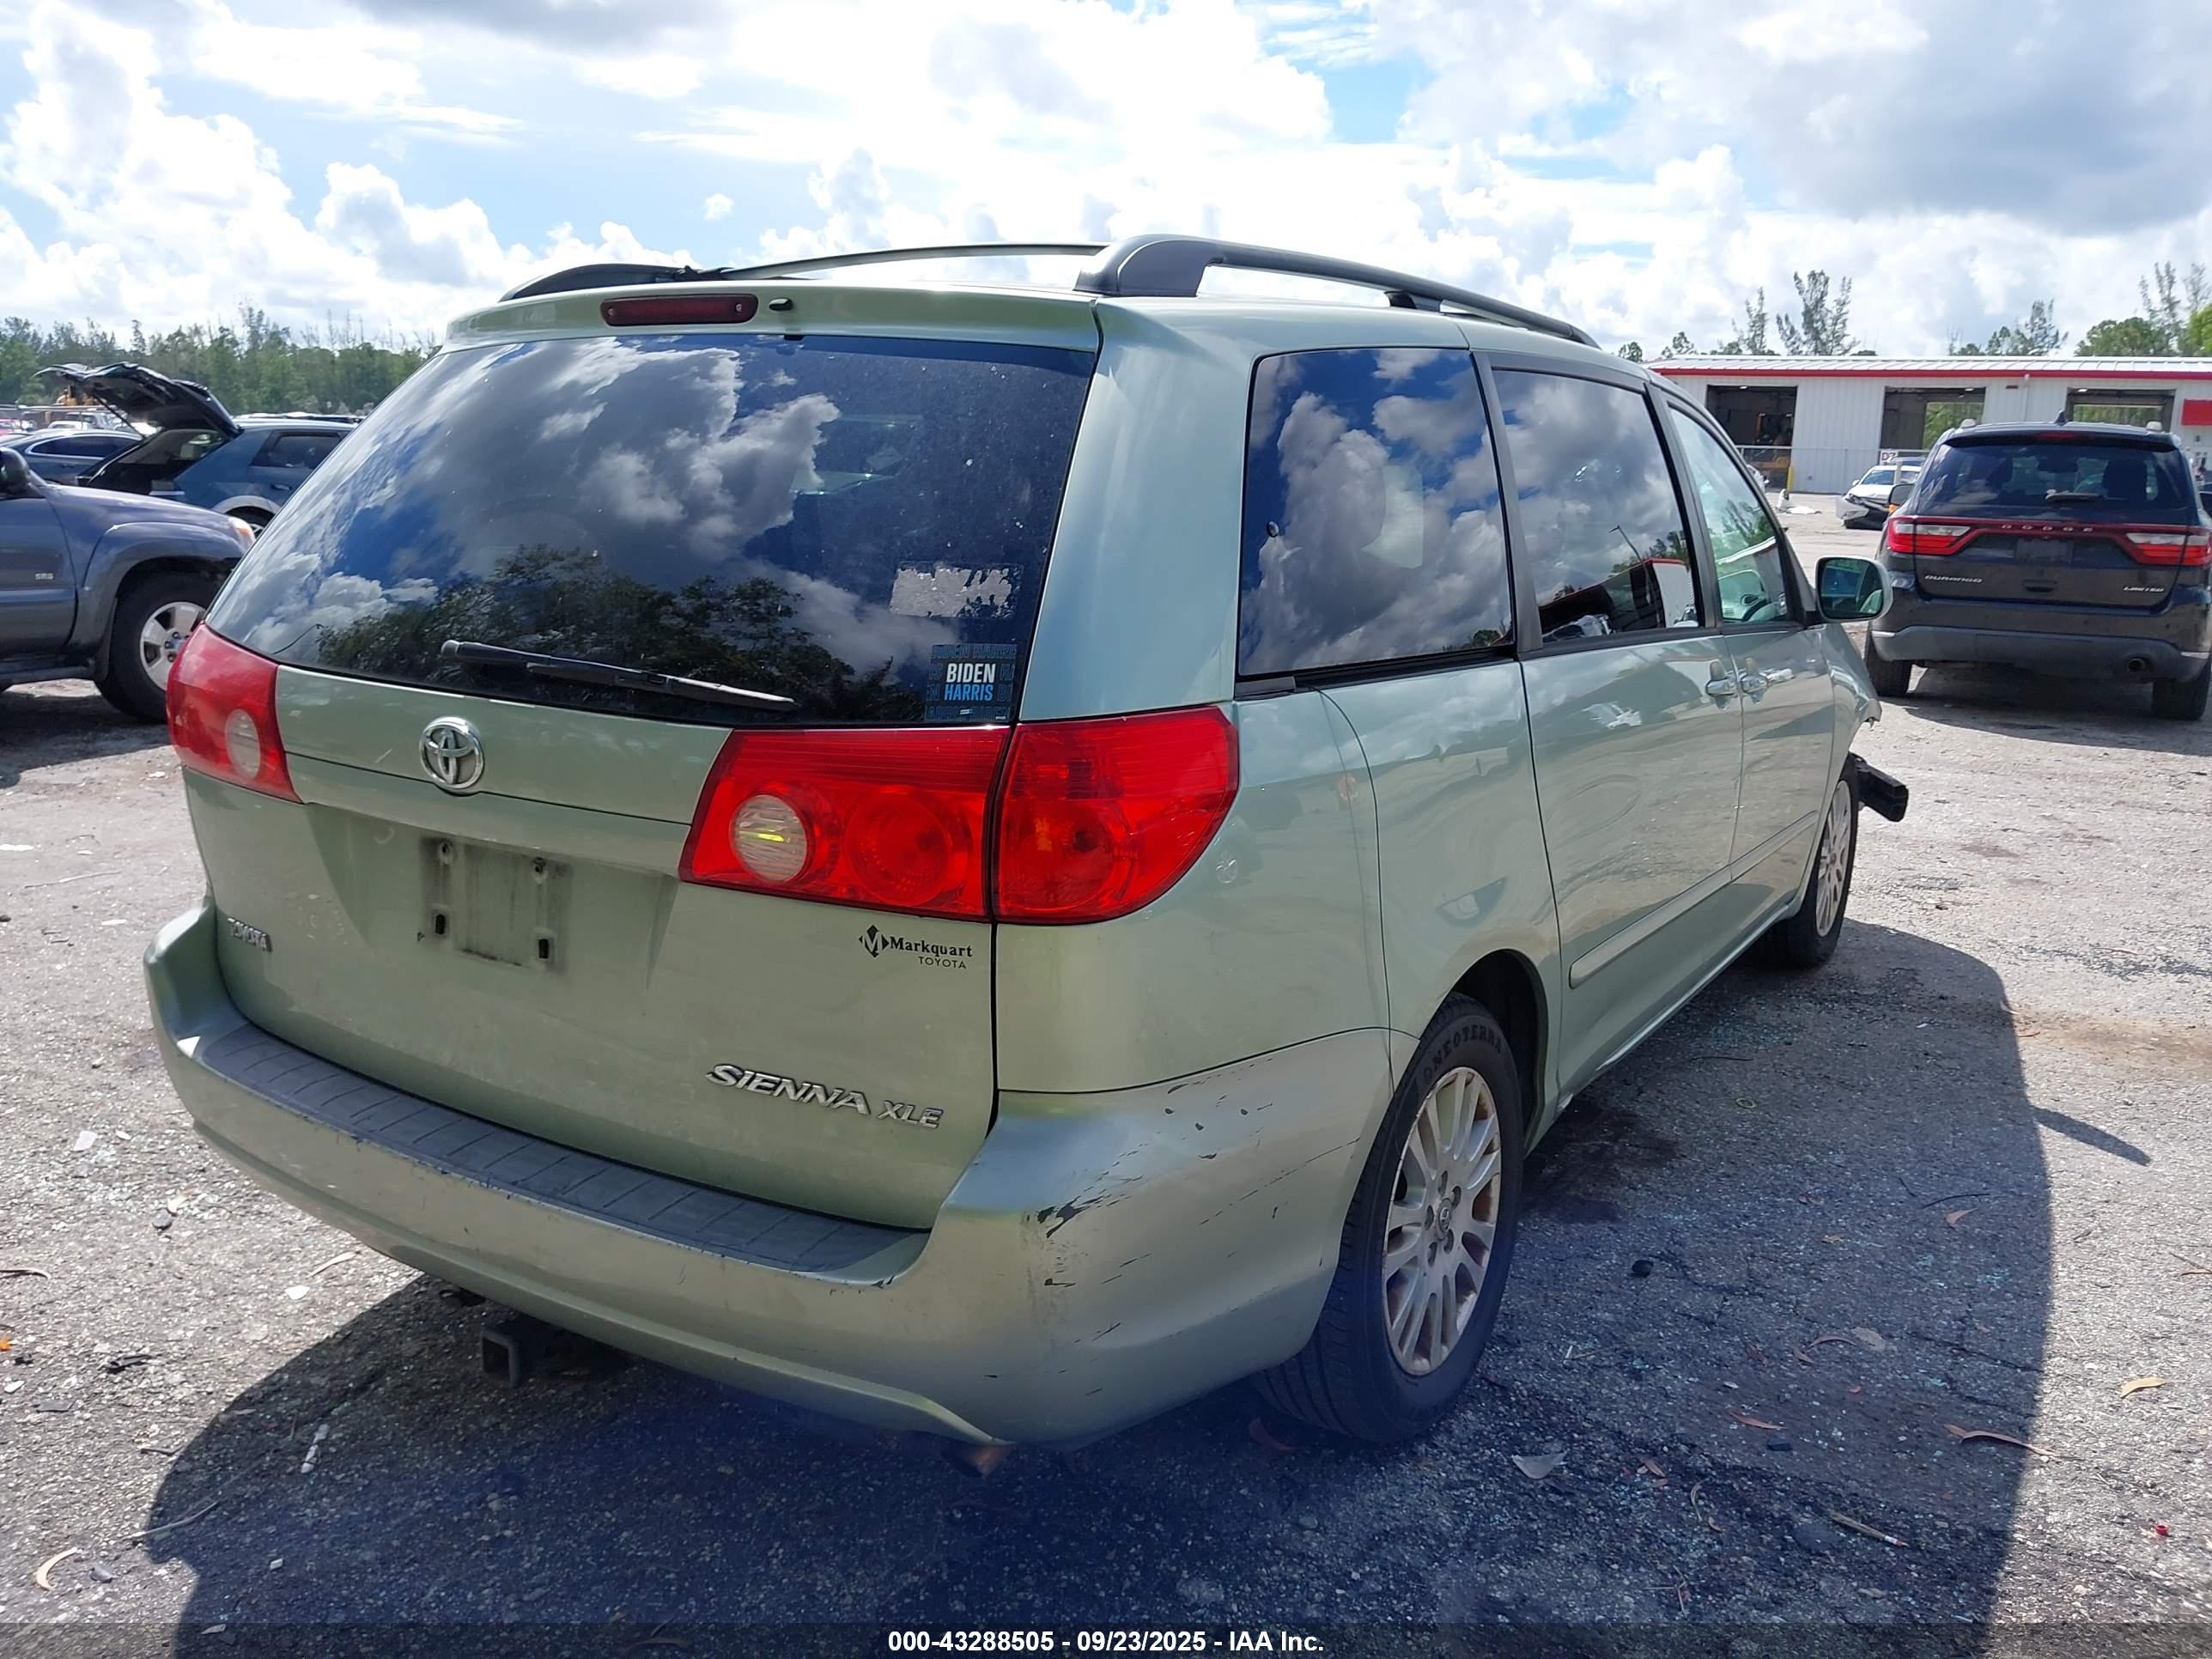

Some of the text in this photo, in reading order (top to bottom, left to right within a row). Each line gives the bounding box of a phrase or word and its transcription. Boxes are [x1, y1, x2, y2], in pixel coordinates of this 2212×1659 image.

[946, 663, 996, 684] BIDEN
[944, 684, 994, 702] HARRIS
[890, 936, 973, 957] Markquart
[918, 956, 967, 969] TOYOTA
[705, 1063, 943, 1128] SIENNA XLE
